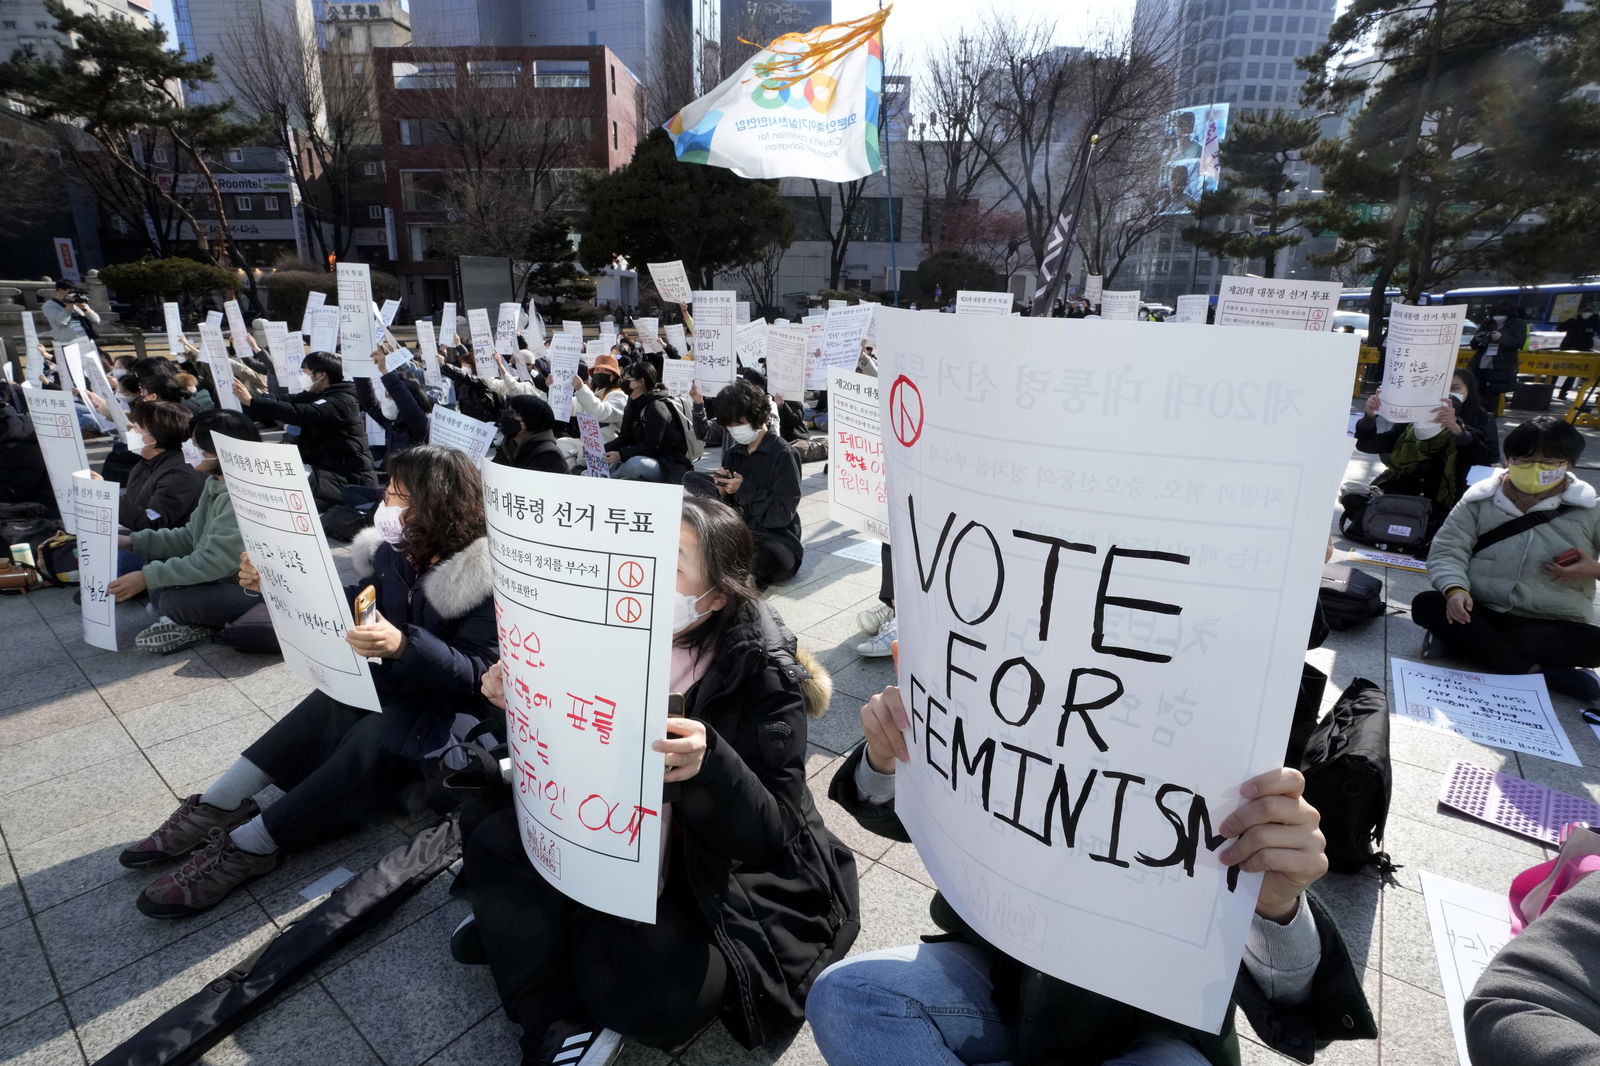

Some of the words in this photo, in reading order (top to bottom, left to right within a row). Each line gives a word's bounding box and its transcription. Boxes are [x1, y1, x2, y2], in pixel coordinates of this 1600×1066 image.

[217, 178, 262, 189] Roomtel
[1228, 285, 1255, 297] 제20대
[1257, 287, 1286, 300] 대통령
[1288, 289, 1308, 301] 선거
[1310, 291, 1331, 301] 투표
[834, 378, 861, 395] 제20대
[863, 386, 880, 400] 대통
[838, 431, 884, 456] 페미니
[255, 458, 273, 477] 선거
[273, 460, 296, 477] 투표
[502, 491, 545, 525] 대통령
[552, 501, 596, 532] 선거
[603, 506, 655, 535] 투표
[534, 555, 563, 573] 정치를
[564, 560, 600, 578] 부수자
[908, 493, 1190, 663] VOTE
[511, 579, 539, 600] 투표한다
[946, 631, 1124, 752] FOR
[909, 673, 1238, 893] FEMINISM
[578, 793, 658, 847] OUT
